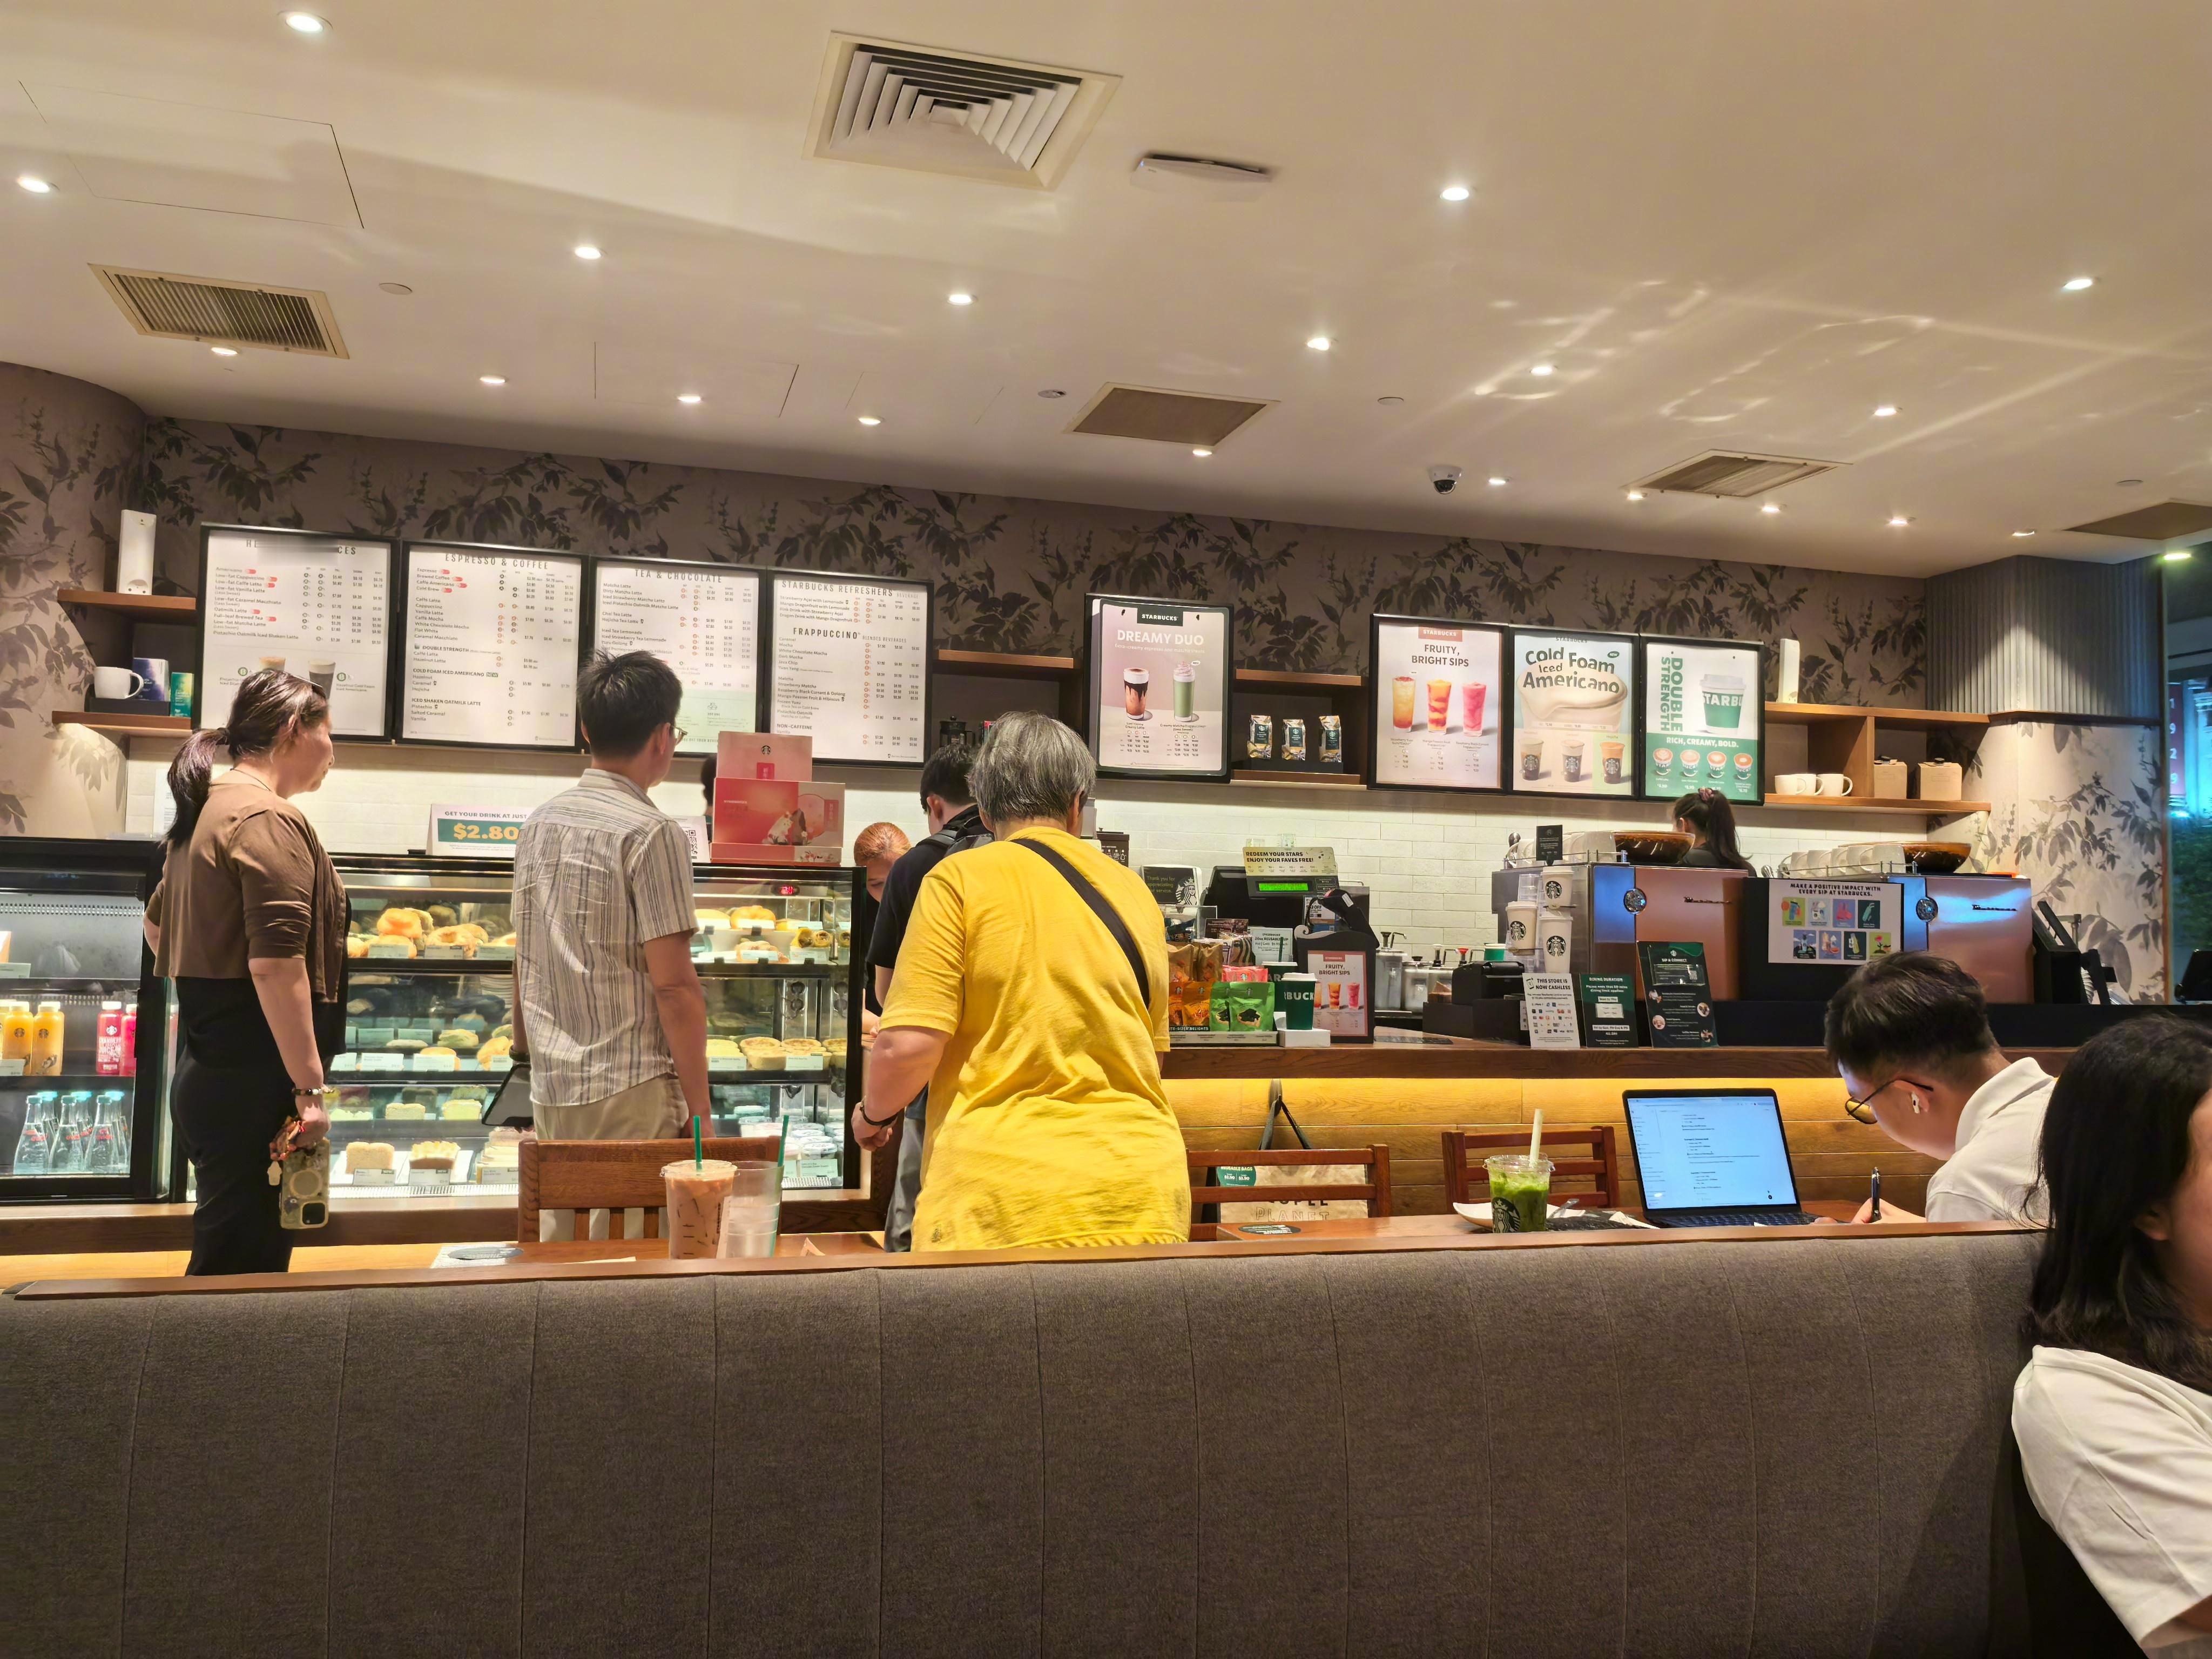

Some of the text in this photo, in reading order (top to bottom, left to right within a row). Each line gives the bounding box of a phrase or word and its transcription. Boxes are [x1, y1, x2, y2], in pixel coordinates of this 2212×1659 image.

[445, 554, 548, 569] ESPRESSO & COFFEE
[635, 569, 651, 578] TEA
[667, 572, 721, 583] CHOCOLATE
[782, 581, 834, 592] STARBUCKS
[839, 586, 893, 596] REFRESHERS
[793, 628, 858, 639] FRAPPUCCINO
[1117, 630, 1204, 645] DREAMY DUO
[1425, 644, 1460, 656] FRUITY,
[1412, 656, 1468, 666] BRIGHT SIPS
[1526, 647, 1615, 674] Cold Foam
[1539, 663, 1562, 673] Iced
[1523, 671, 1619, 693] Americano
[1660, 657, 1670, 731] STRENGTH
[1670, 658, 1683, 731] DOUBLE
[454, 823, 519, 840] $2.80
[1256, 1206, 1330, 1222] PLANET
